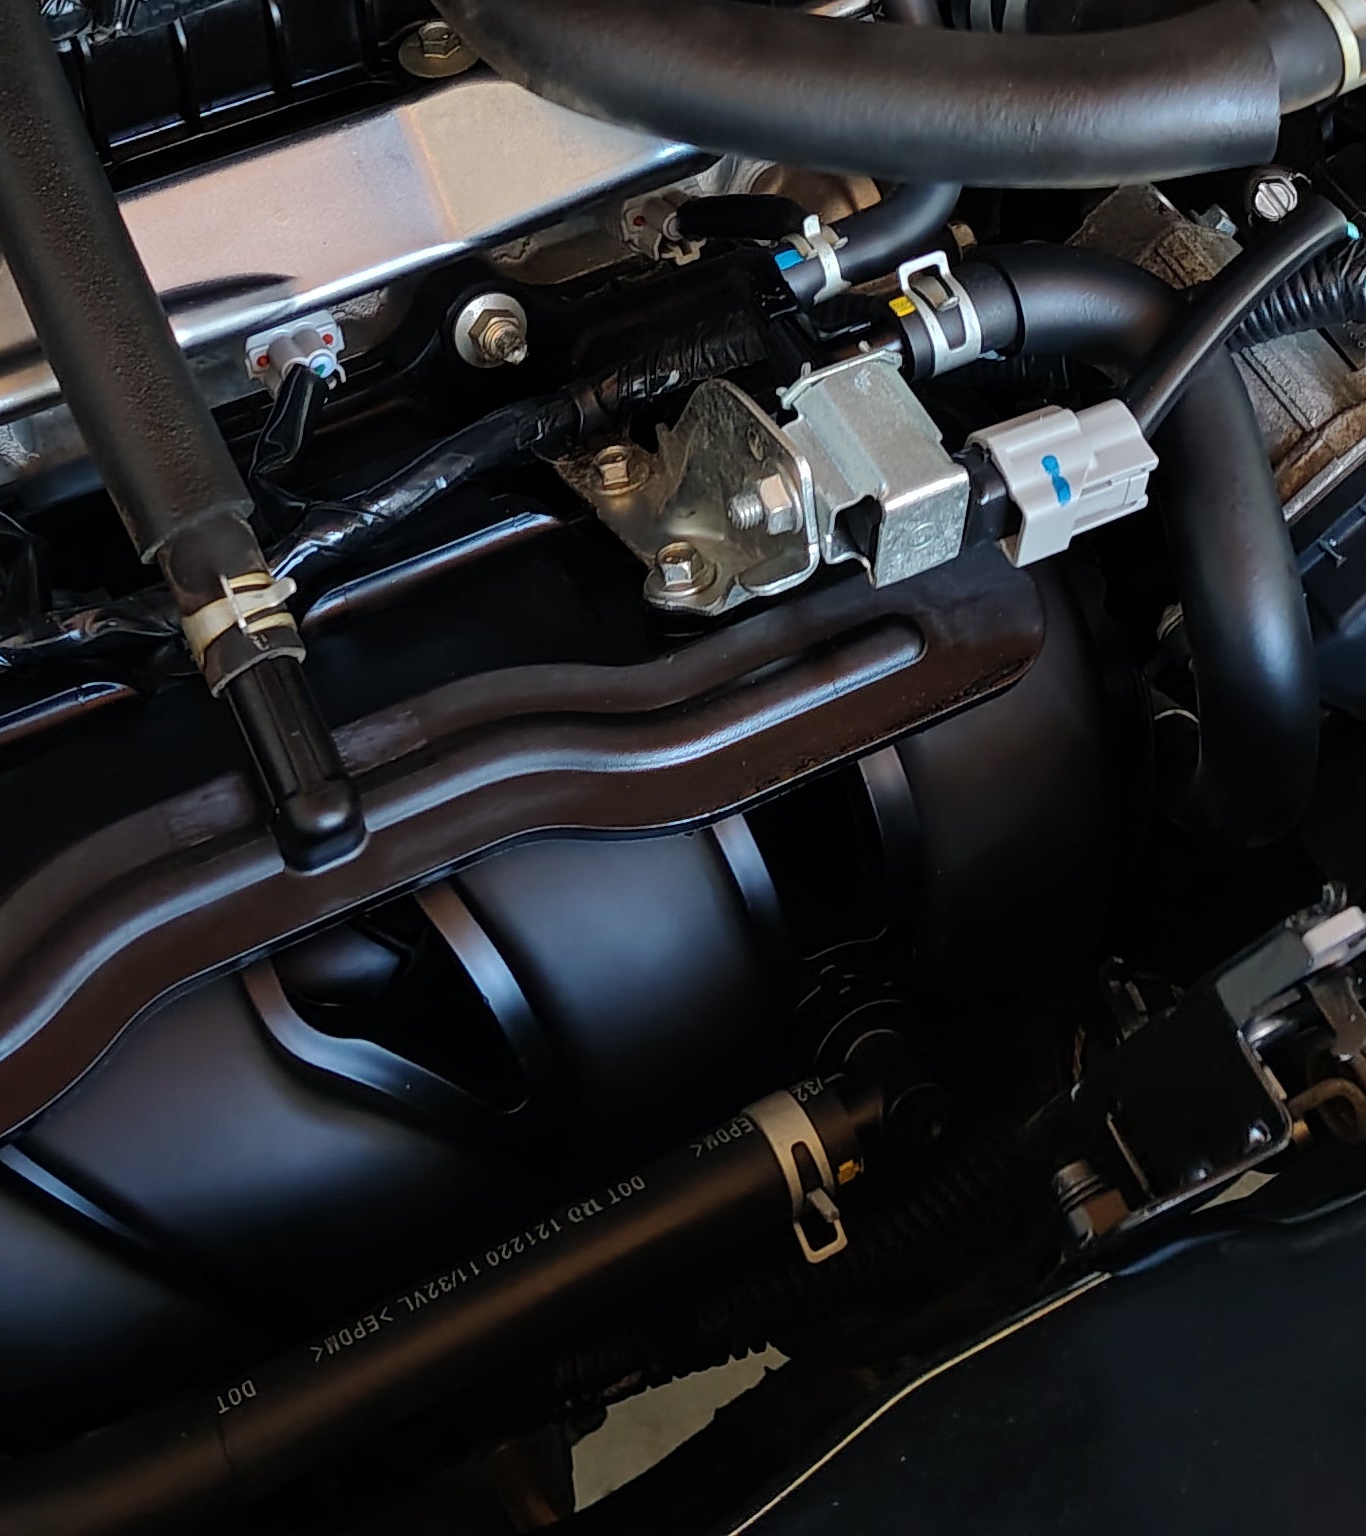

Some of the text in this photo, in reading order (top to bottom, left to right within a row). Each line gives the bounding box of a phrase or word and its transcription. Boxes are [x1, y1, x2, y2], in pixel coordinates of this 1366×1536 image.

[689, 1116, 755, 1159] EPDM<
[607, 1173, 647, 1206] DOT
[485, 1217, 562, 1267] 121220
[214, 1378, 257, 1417] DOT
